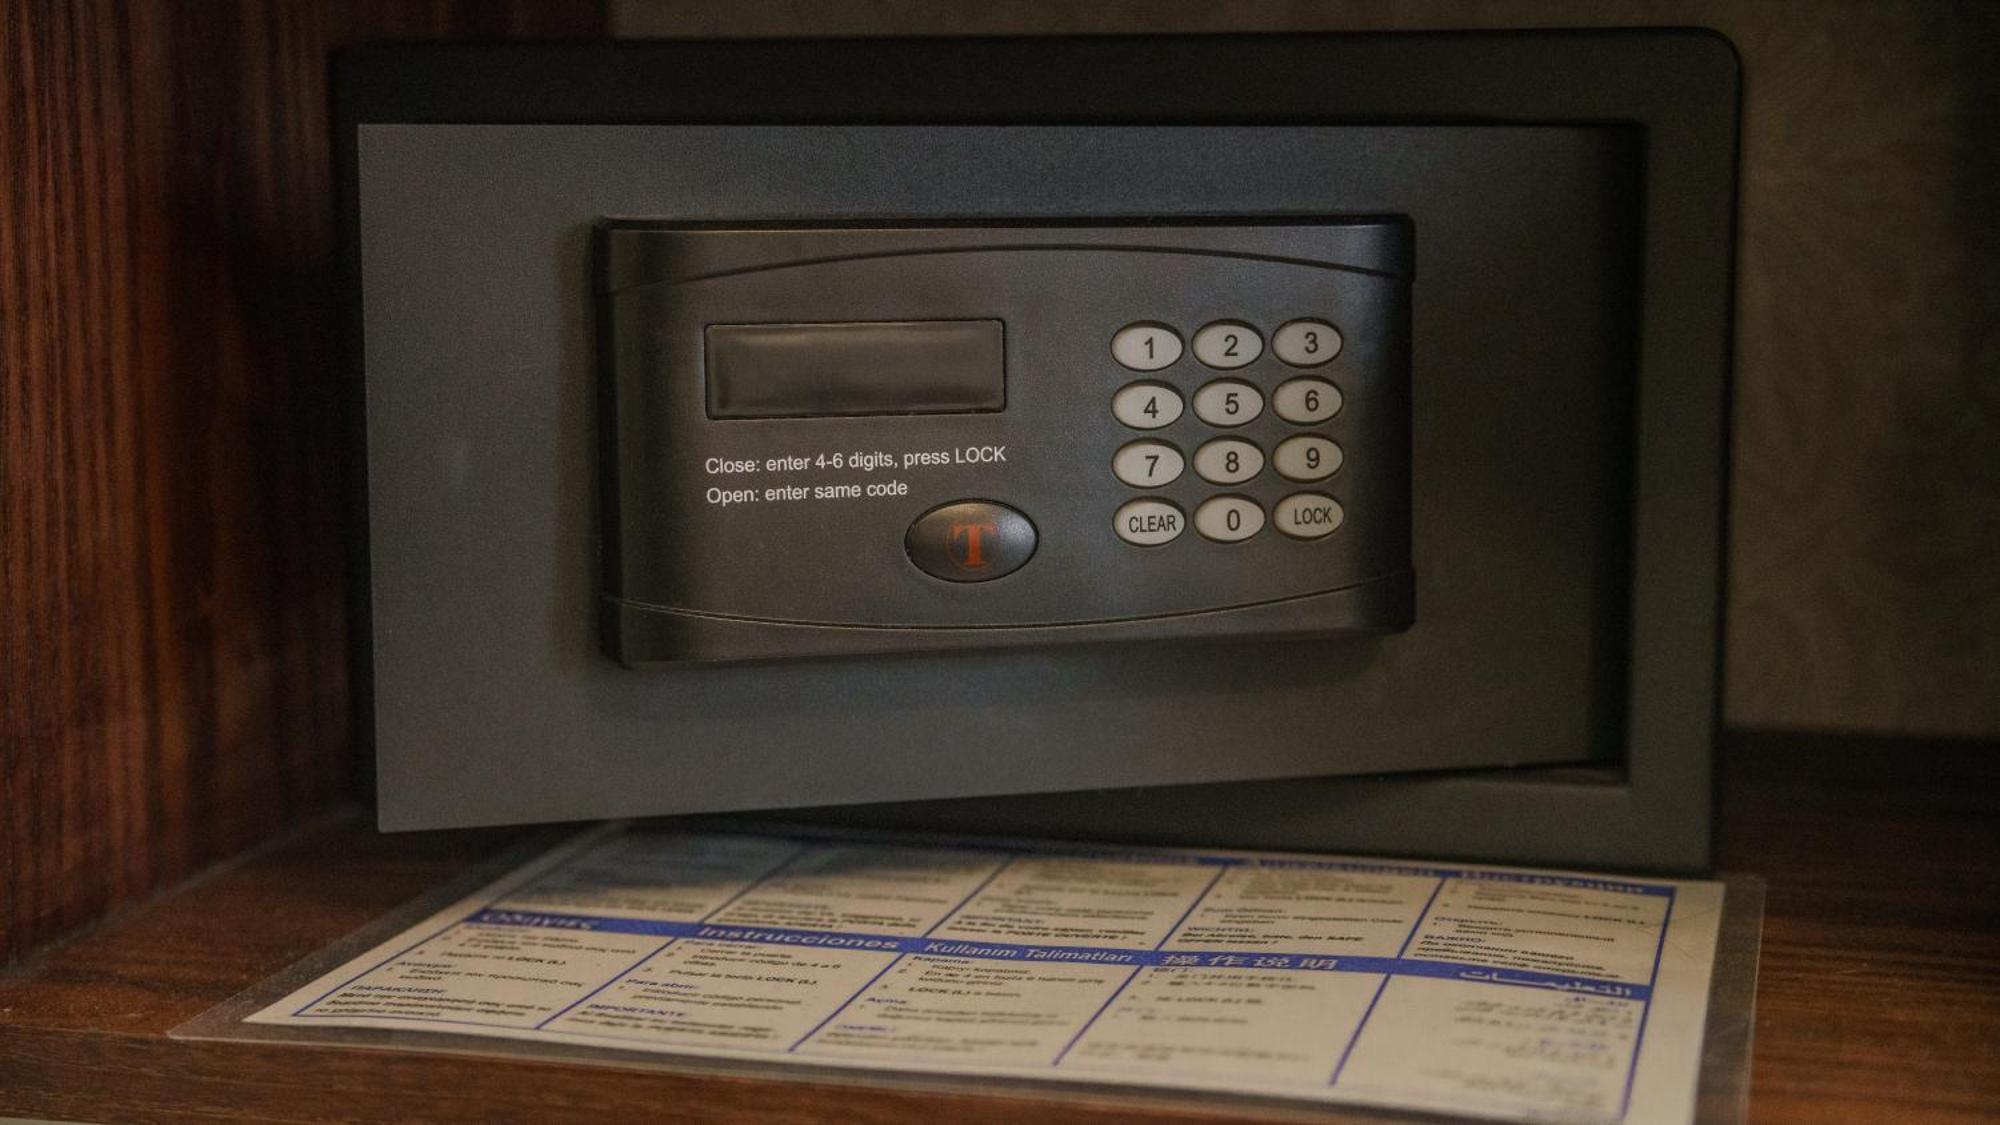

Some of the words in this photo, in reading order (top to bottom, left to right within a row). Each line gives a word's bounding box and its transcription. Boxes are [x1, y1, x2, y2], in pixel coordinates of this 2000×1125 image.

[1144, 336, 1154, 360] 1
[1224, 334, 1239, 357] 2
[1304, 332, 1319, 354] 3
[1143, 396, 1159, 419] 4
[1225, 392, 1240, 415] 5
[1305, 389, 1320, 412] 6
[705, 457, 760, 474] Close:
[766, 455, 811, 472] enter
[815, 453, 844, 469] 4-6
[849, 451, 899, 471] digits,
[903, 450, 950, 470] press
[955, 446, 1007, 464] LOCK
[1145, 455, 1160, 477] 7
[1225, 451, 1240, 474] 8
[1306, 447, 1321, 469] 9
[706, 486, 759, 507] Open:
[765, 484, 809, 501] enter
[814, 483, 861, 499] same
[866, 480, 908, 497] code
[1129, 514, 1177, 534] CLEAR
[1227, 509, 1241, 531] 0
[1294, 507, 1332, 525] LOCK
[952, 521, 997, 569] T
[697, 925, 901, 949] Instrucciones
